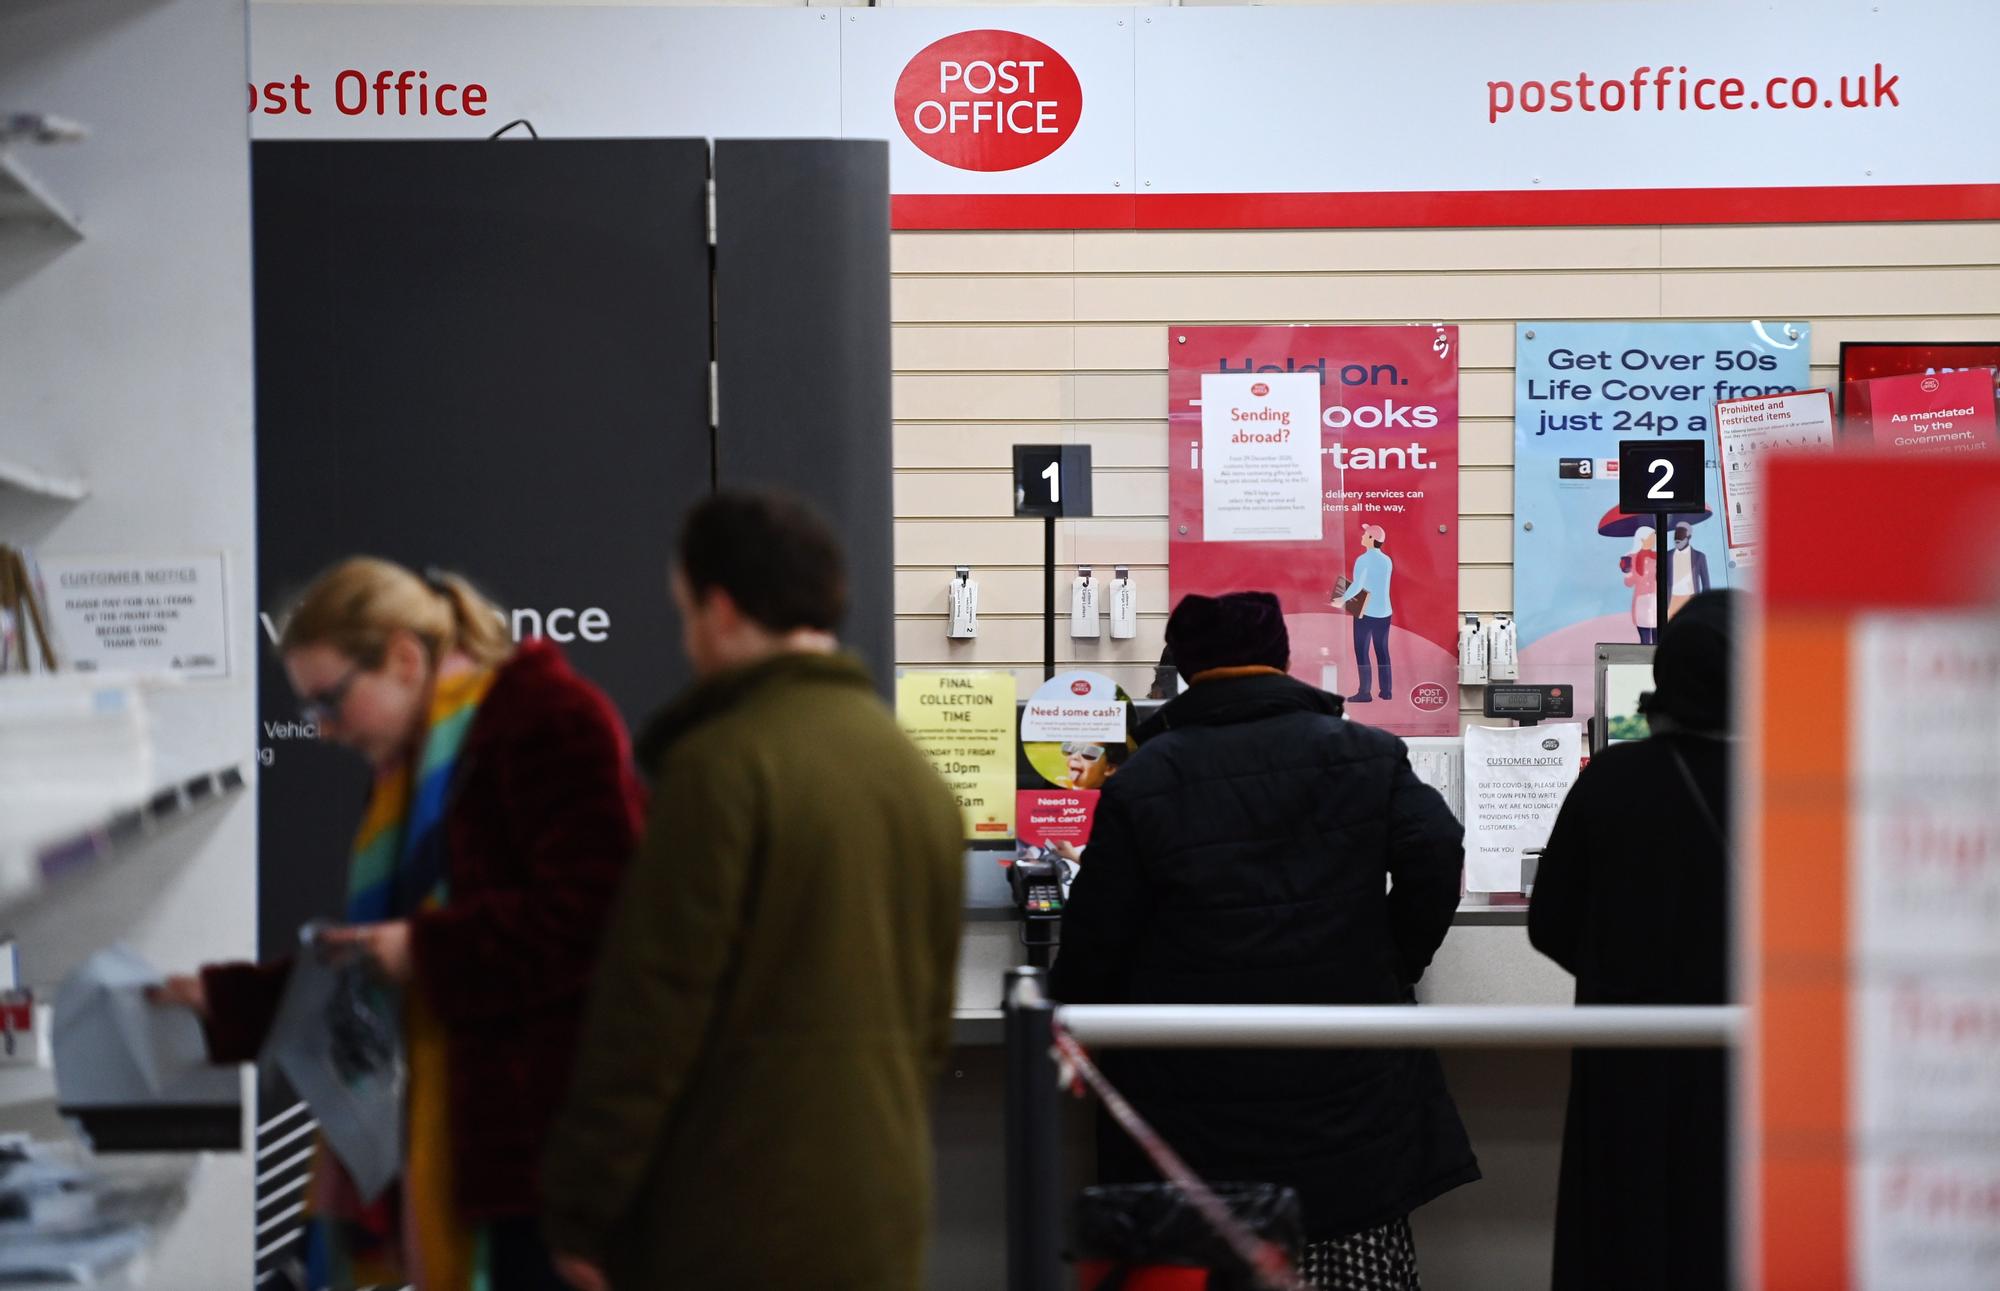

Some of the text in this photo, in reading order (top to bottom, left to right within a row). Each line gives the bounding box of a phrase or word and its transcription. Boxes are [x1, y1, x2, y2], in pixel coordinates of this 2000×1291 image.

[940, 60, 1044, 94] POST
[334, 69, 488, 117] Office
[1486, 63, 1901, 124] postoffice.co.uk
[914, 100, 1059, 135] OFFICE
[1548, 348, 1778, 371] Get Over 50s
[1341, 363, 1409, 386] on.
[1527, 379, 1592, 401] Life
[1601, 379, 1705, 401] Cover
[1231, 405, 1291, 426] Sending
[1720, 400, 1784, 416] Prohibited and
[1891, 406, 1975, 423] As mandated
[1535, 409, 1610, 436] just
[1612, 410, 1679, 436] 24p
[1687, 415, 1707, 432] a
[1721, 411, 1791, 426] restricted items
[1914, 421, 1953, 433] by the
[1231, 428, 1291, 444] abroad?
[1041, 461, 1060, 503] 1
[1646, 458, 1675, 499] 2
[1325, 489, 1424, 500] delivery services can
[1322, 502, 1406, 514] items all the way.
[939, 678, 974, 689] FINAL
[919, 694, 994, 705] COLLECTION
[1414, 696, 1444, 704] OFFICE
[1419, 688, 1441, 697] POST
[942, 710, 972, 722] TIME
[1031, 706, 1122, 717] Need some cash?
[1486, 756, 1564, 766] CUSTOMER NOTICE
[1502, 782, 1533, 790] COVID-19,
[1037, 797, 1080, 806] Need to
[1030, 814, 1088, 823] bank card?
[1062, 807, 1087, 816] your
